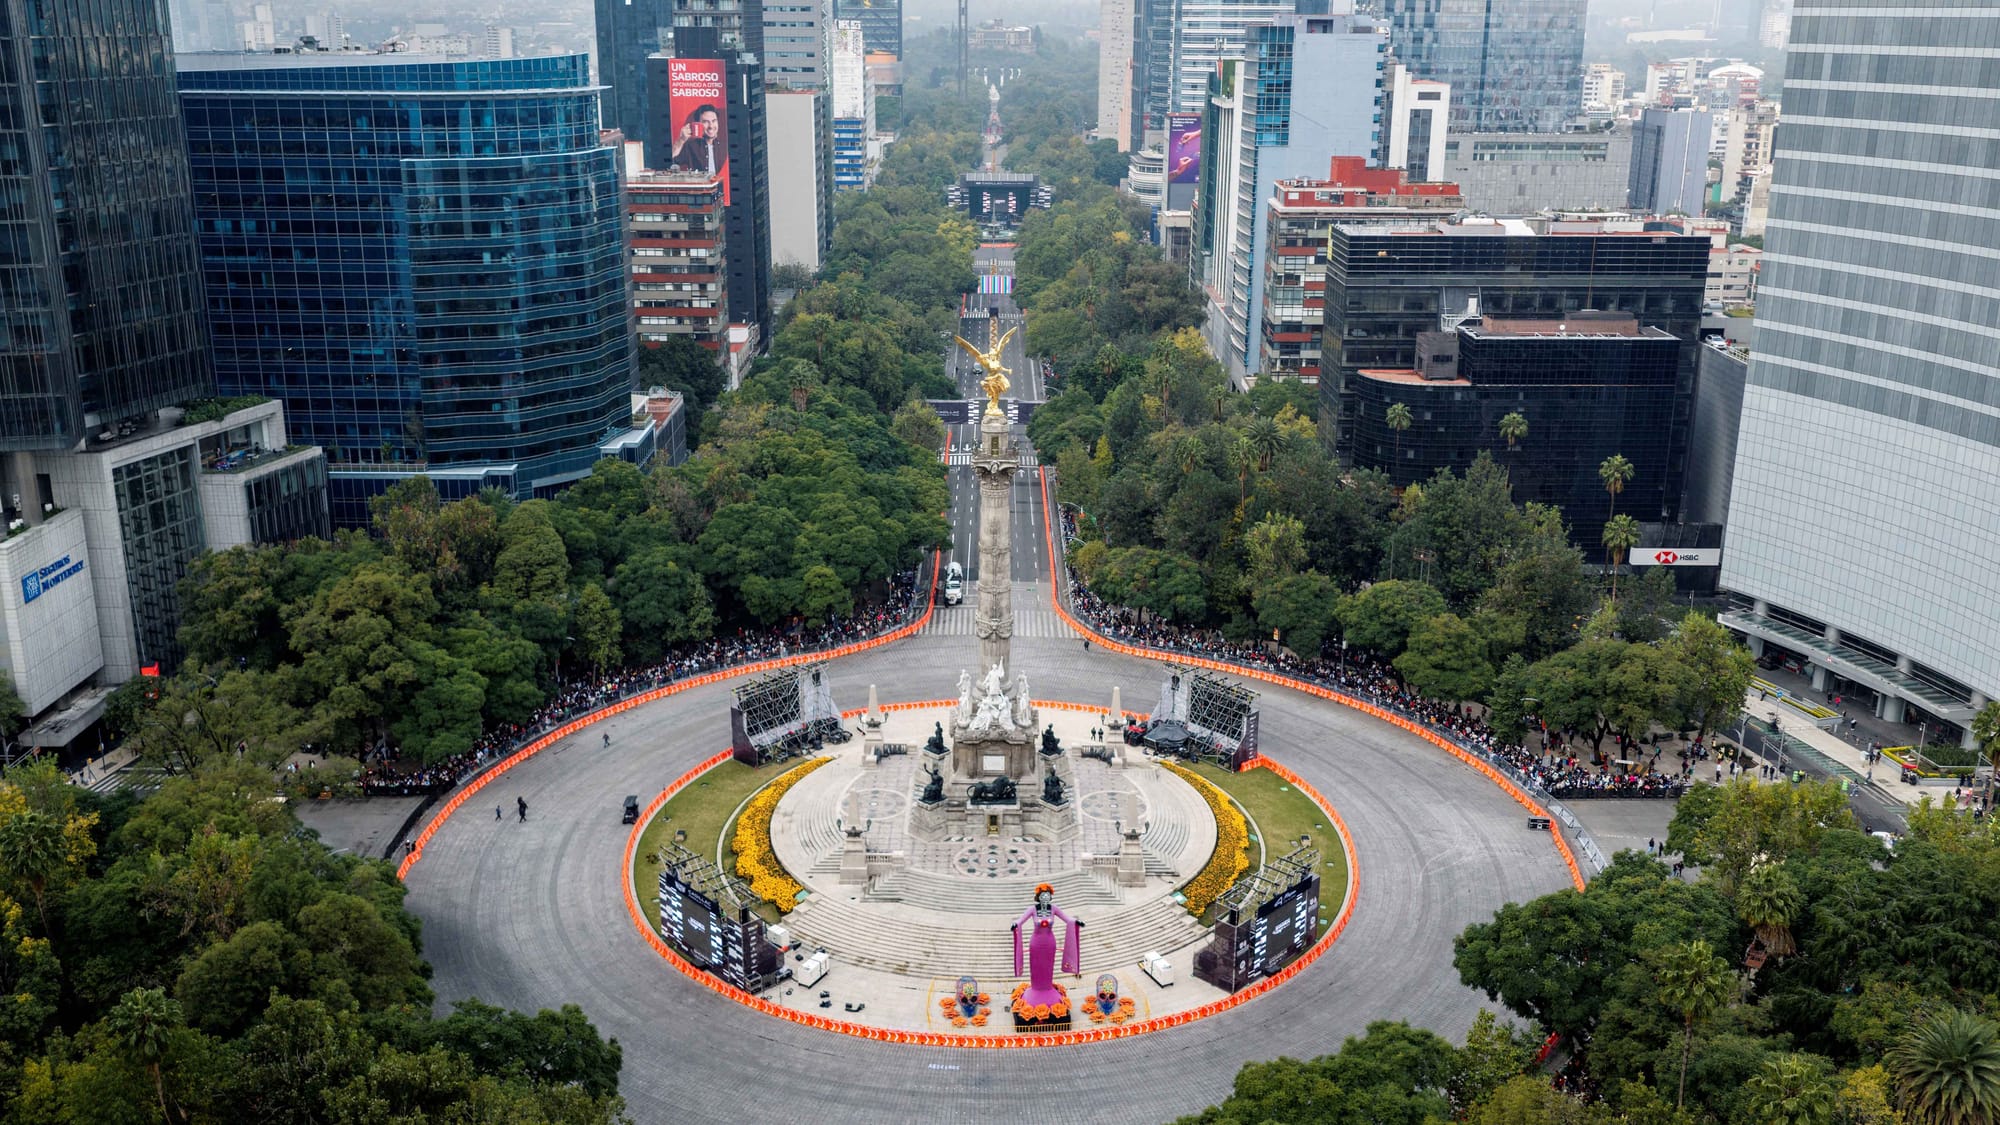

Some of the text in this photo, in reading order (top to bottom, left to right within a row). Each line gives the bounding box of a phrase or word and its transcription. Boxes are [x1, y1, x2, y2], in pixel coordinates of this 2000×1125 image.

[671, 63, 686, 71] UN
[671, 72, 719, 81] SABROSO
[672, 88, 719, 97] SABROSO
